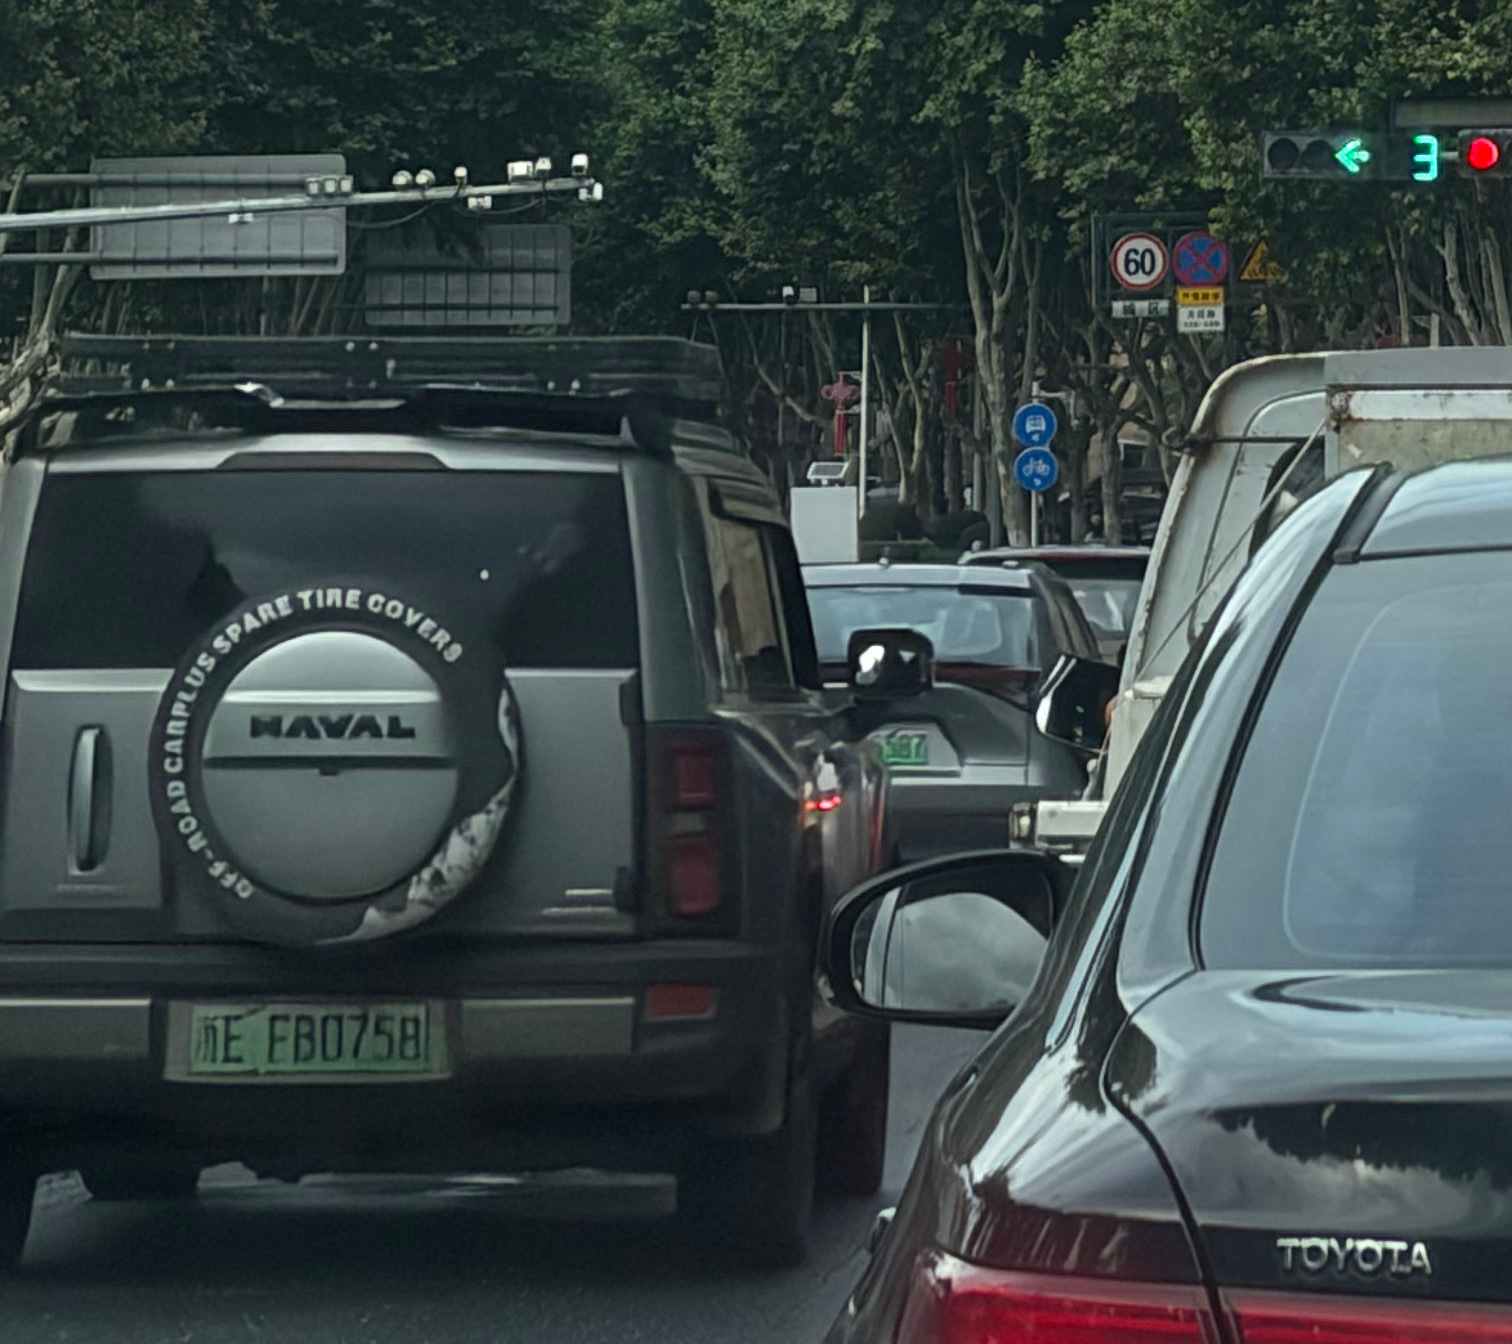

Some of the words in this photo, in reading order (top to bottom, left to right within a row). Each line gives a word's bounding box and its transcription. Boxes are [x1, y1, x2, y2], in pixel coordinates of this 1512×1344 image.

[1412, 134, 1438, 181] 3
[1123, 248, 1156, 277] 60
[166, 780, 255, 900] OFF-ROAD
[212, 594, 294, 655] SPARE
[297, 587, 362, 610] TIRE
[366, 592, 463, 663] COVERS
[250, 714, 416, 740] HAVAL
[1276, 1237, 1433, 1275] TOYOTA
